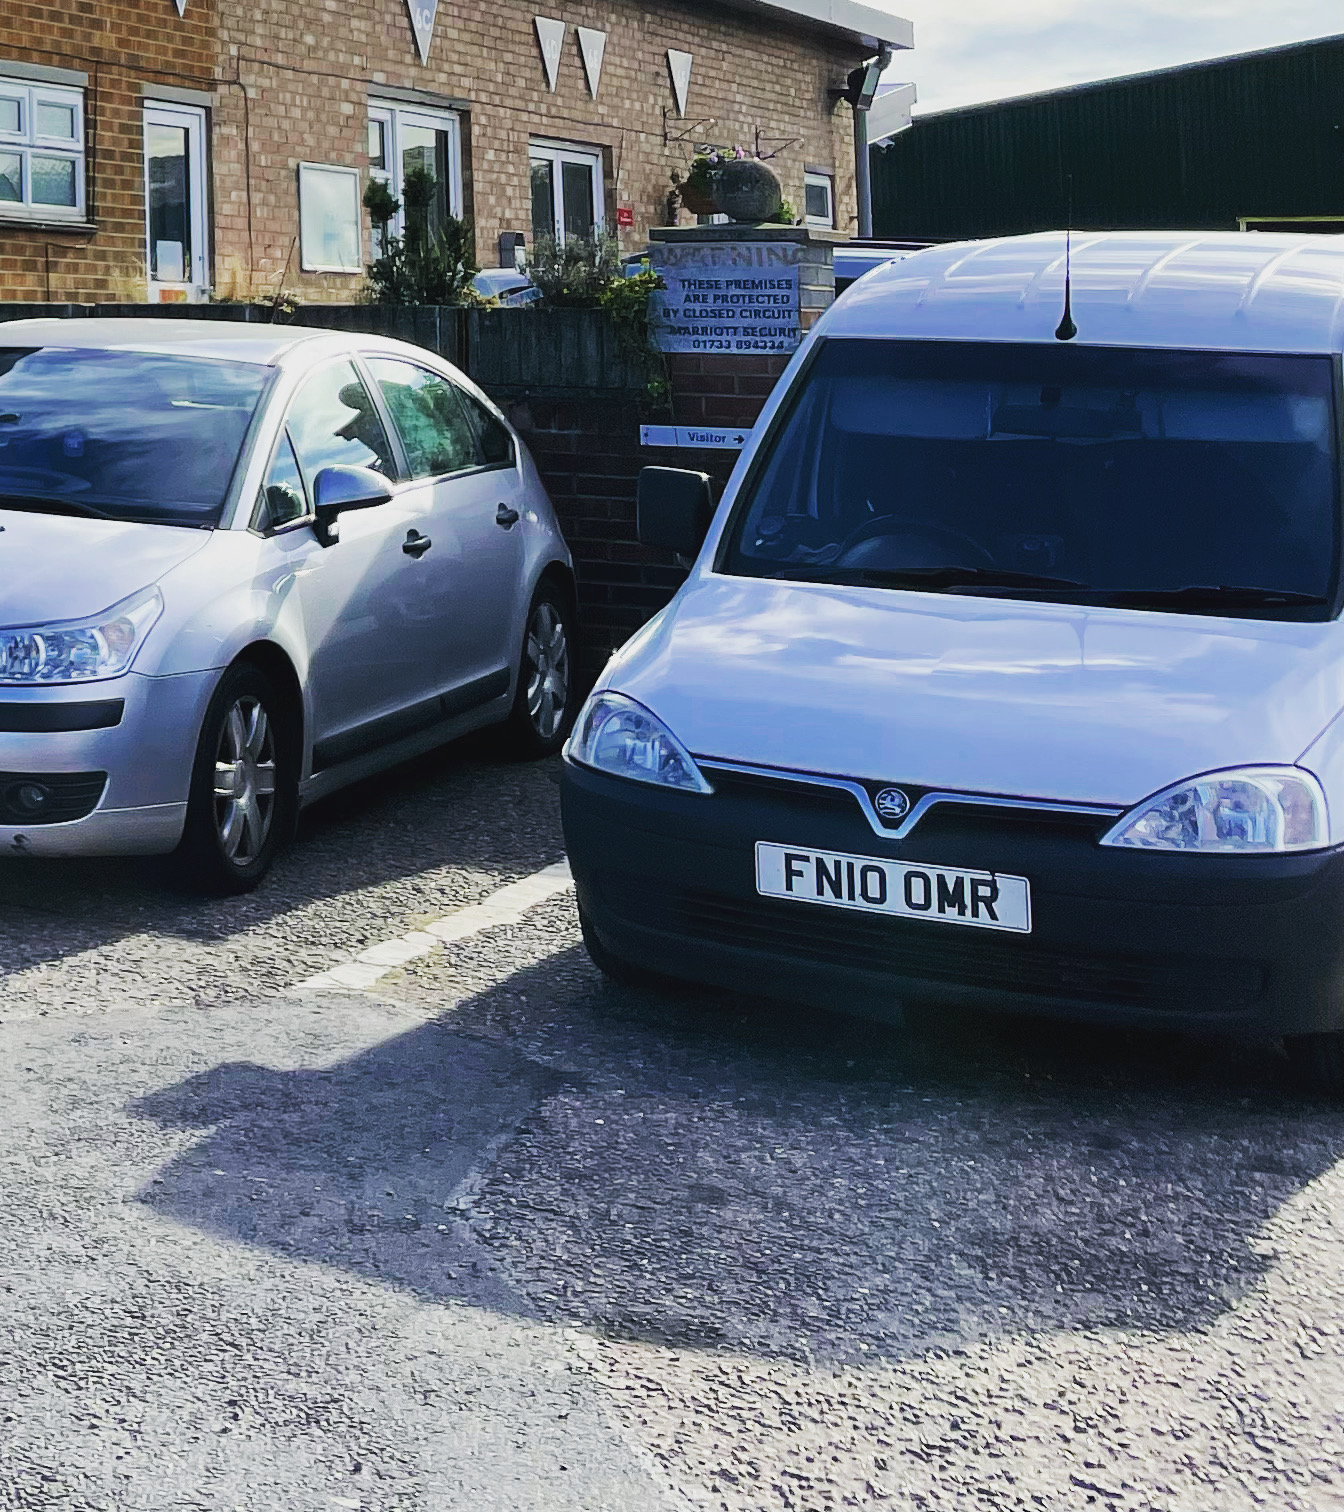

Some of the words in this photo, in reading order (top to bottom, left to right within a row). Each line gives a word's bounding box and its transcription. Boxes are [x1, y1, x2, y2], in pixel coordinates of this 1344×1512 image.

[415, 8, 431, 31] 6C
[680, 279, 722, 290] THESE
[725, 279, 792, 290] PREMISES
[683, 294, 709, 304] ARE
[713, 294, 790, 305] PROTECTED
[663, 308, 679, 318] BY
[683, 308, 735, 319] CLOSED
[739, 309, 793, 319] CIRCUIT
[692, 340, 731, 349] 01733
[687, 431, 726, 444] Visitor
[784, 852, 887, 905] FN10
[904, 870, 999, 921] OMR
